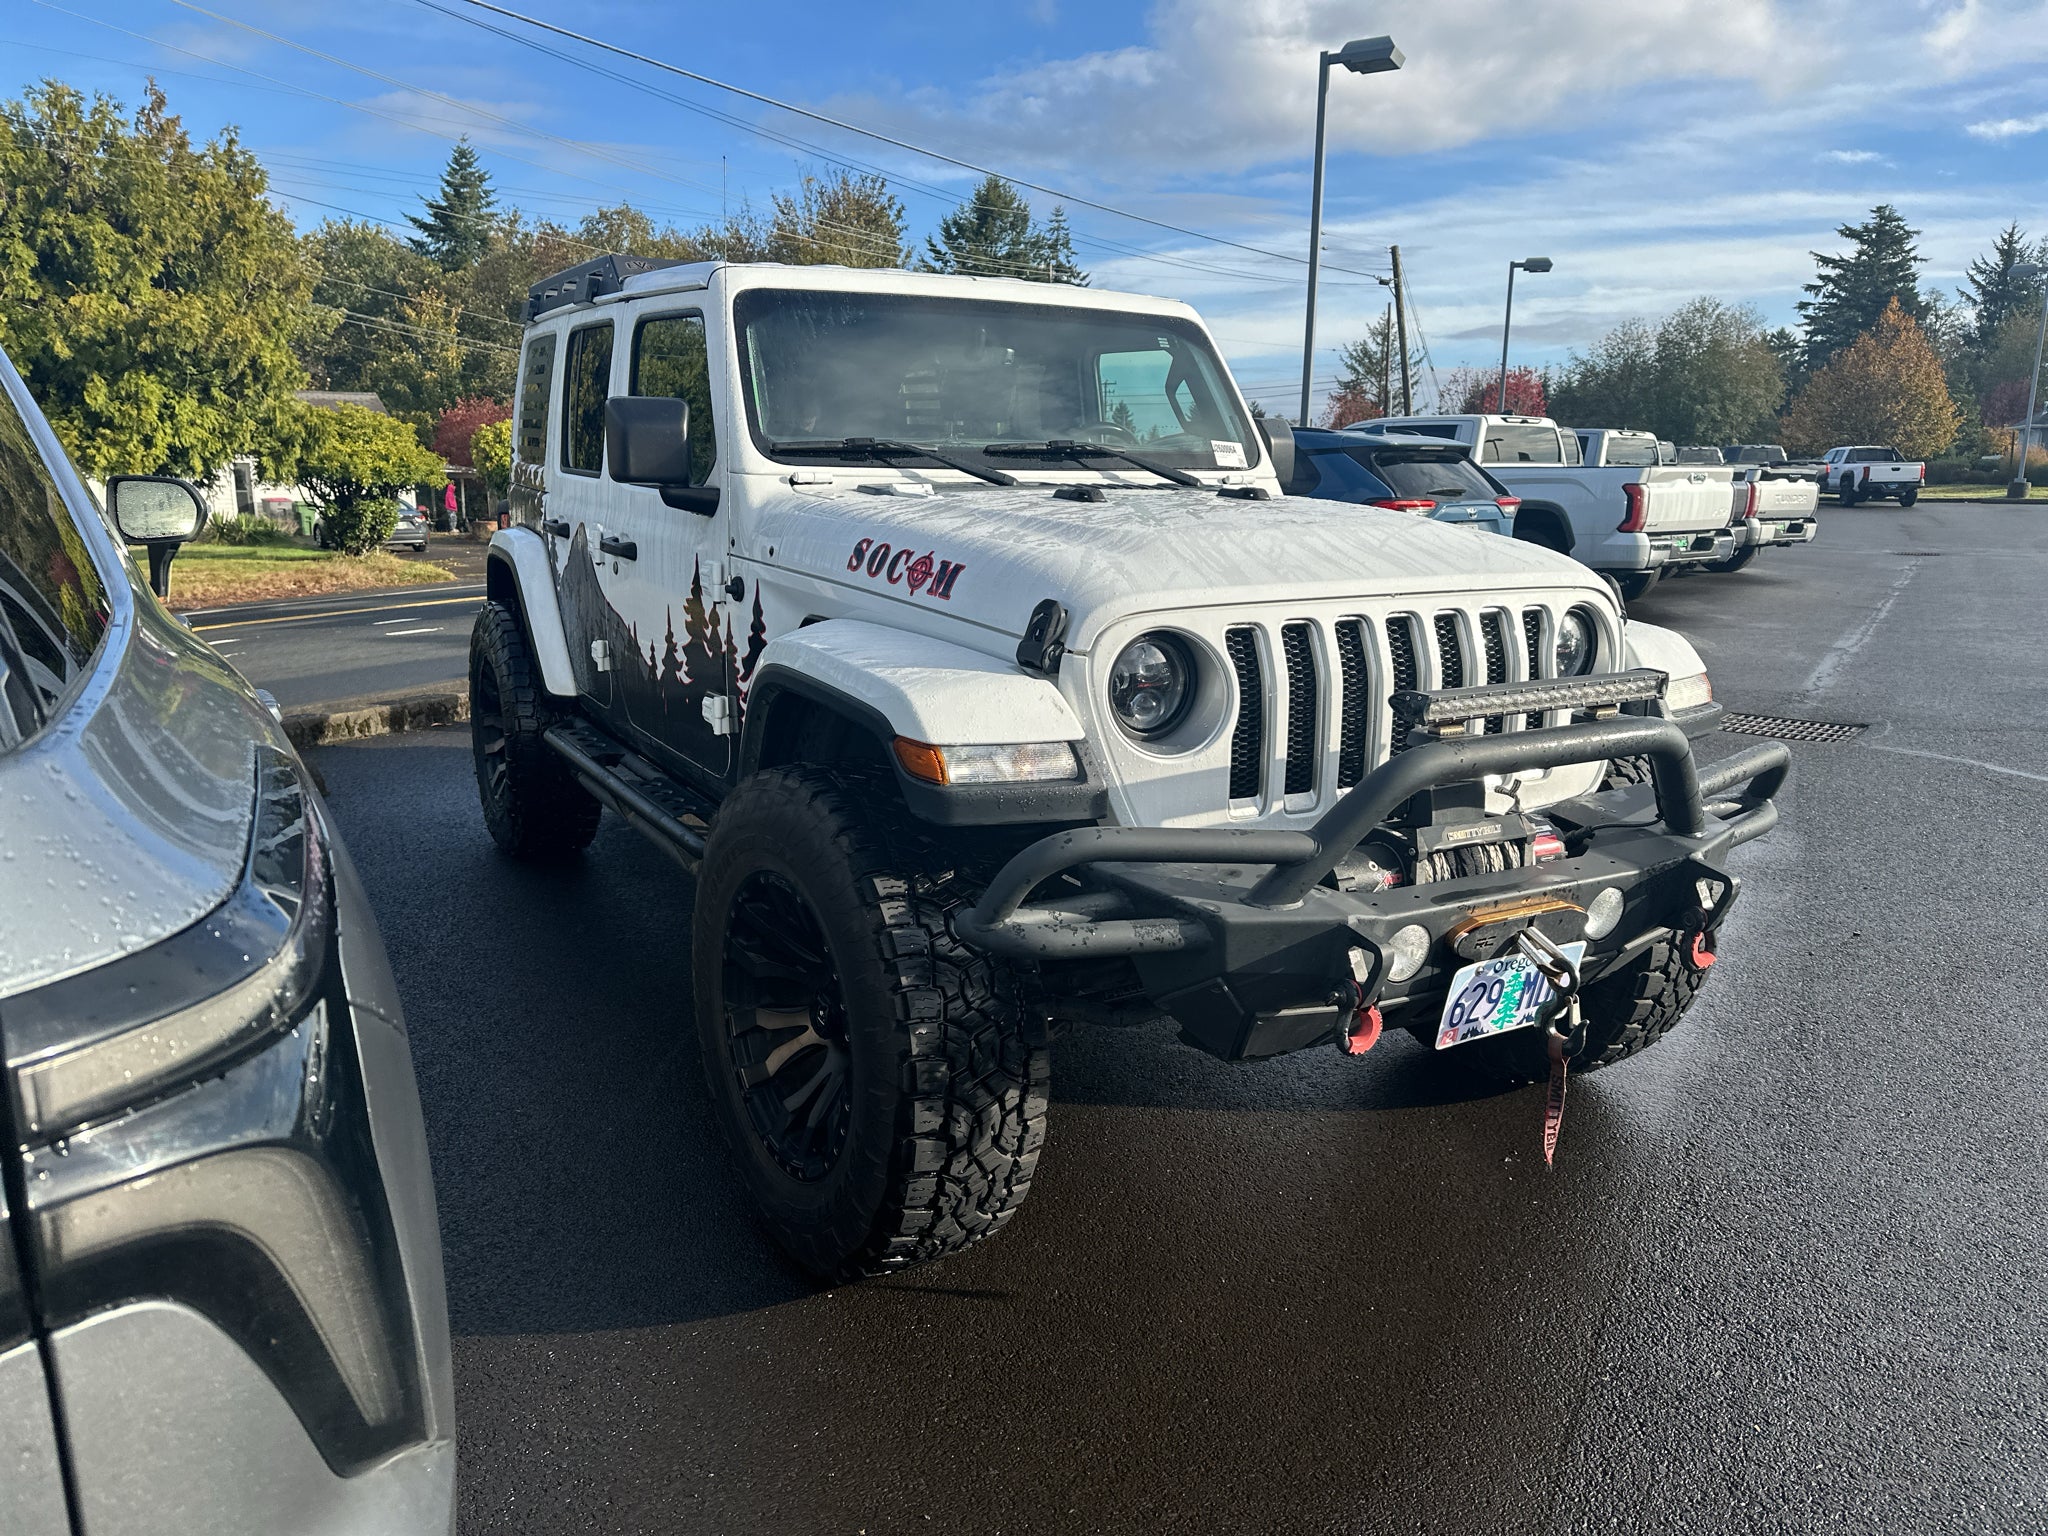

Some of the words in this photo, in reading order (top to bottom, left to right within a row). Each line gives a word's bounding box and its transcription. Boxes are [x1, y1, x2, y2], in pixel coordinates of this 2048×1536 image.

[846, 537, 966, 600] SOCOM
[1493, 957, 1533, 974] Orego
[1449, 978, 1506, 1028] 629
